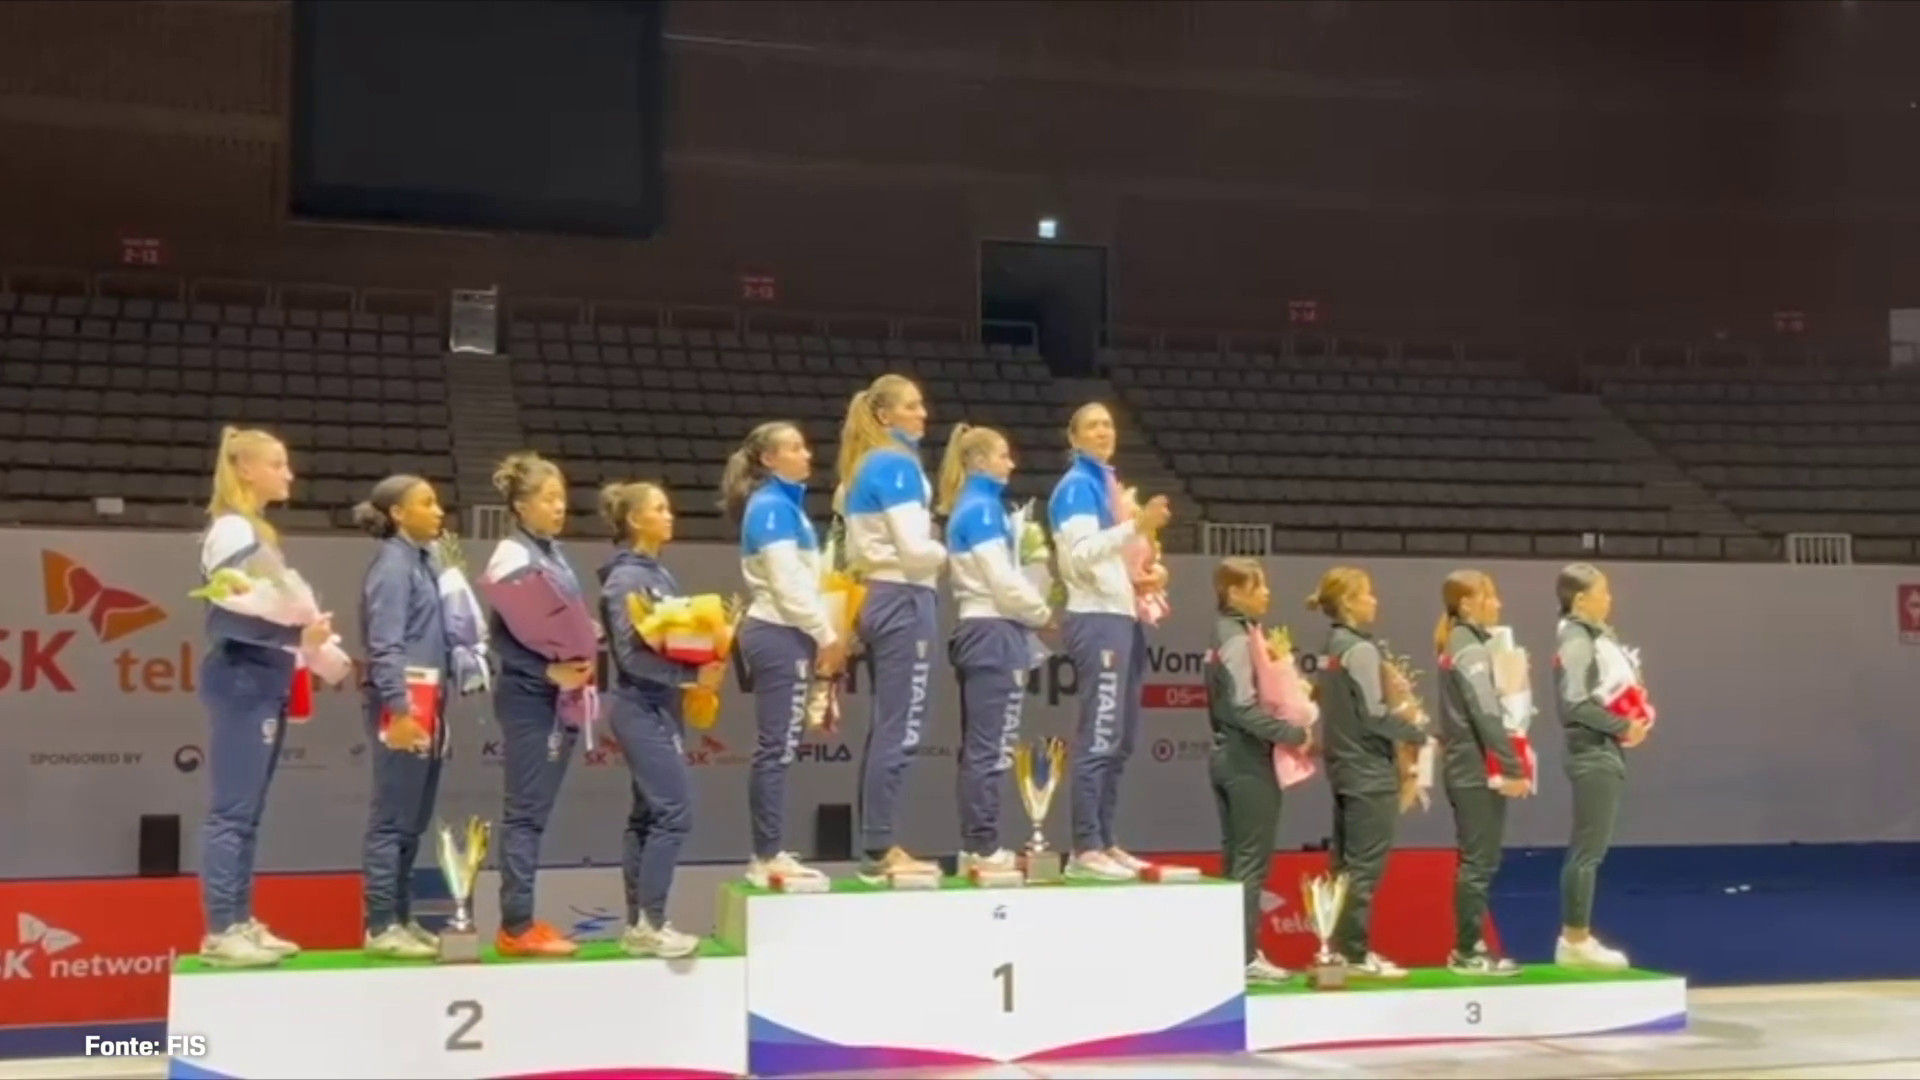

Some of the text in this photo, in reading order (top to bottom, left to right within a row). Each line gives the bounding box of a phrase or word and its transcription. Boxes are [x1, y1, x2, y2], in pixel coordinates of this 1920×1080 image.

[902, 662, 931, 747] ITALIA
[1089, 671, 1118, 753] ITALIA
[29, 752, 143, 767] SPONSORED BY
[797, 743, 852, 763] FILA
[0, 949, 35, 980] K
[993, 962, 1015, 1013] 1
[445, 999, 484, 1052] 2
[1464, 1002, 1482, 1025] 3
